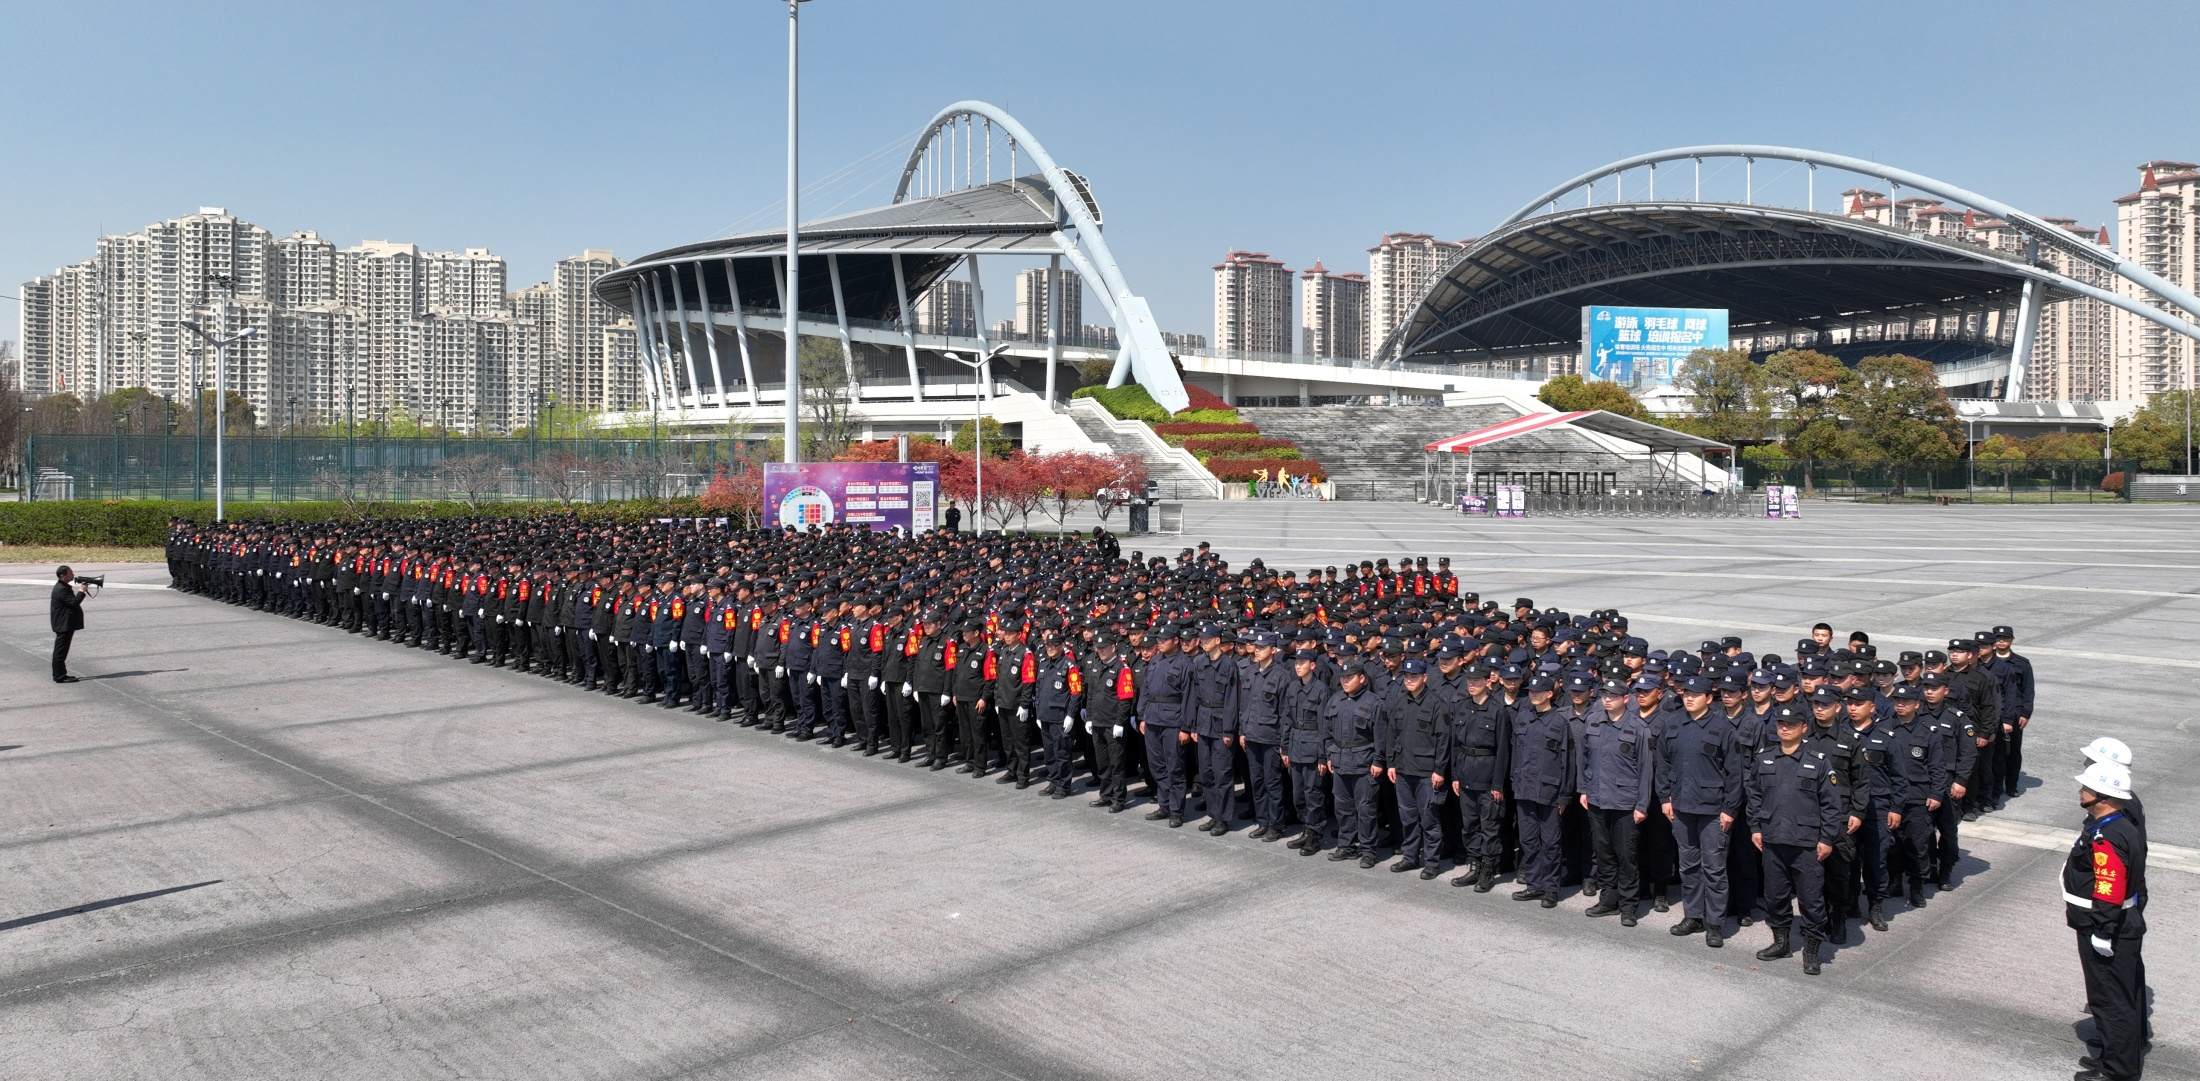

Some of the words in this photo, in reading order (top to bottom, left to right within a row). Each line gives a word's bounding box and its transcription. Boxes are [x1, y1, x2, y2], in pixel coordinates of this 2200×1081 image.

[1615, 316, 1638, 329] 游泳
[1644, 316, 1679, 330] 羽毛球
[1684, 318, 1707, 331] 网球
[1618, 329, 1641, 342] 篮球
[1647, 330, 1704, 344] 培训报名中
